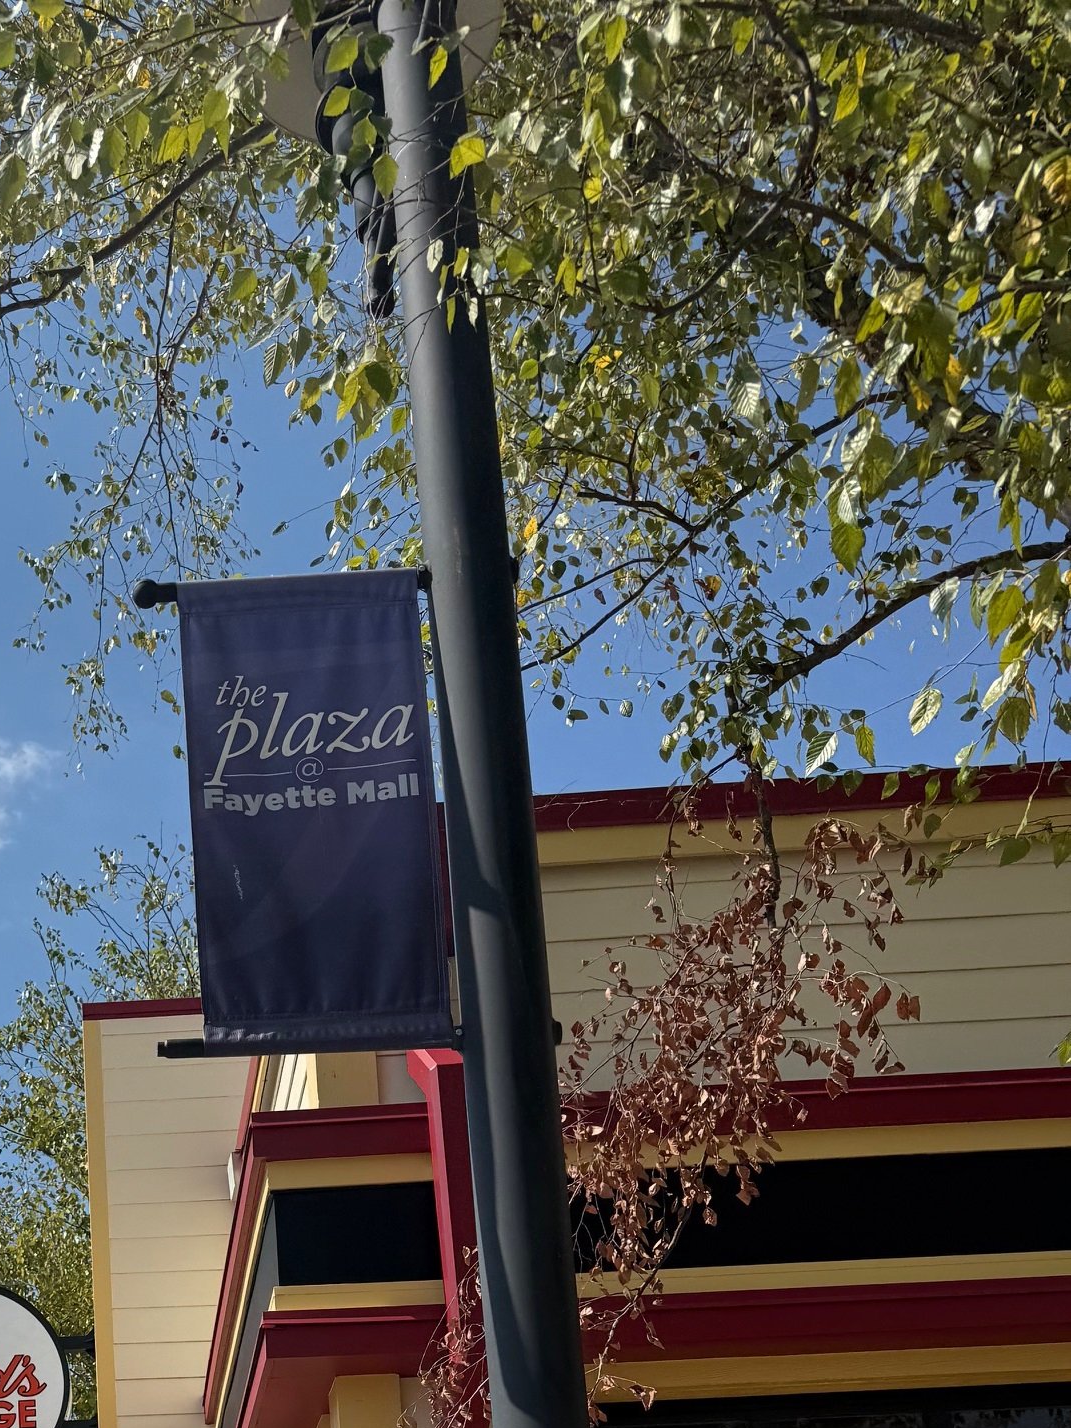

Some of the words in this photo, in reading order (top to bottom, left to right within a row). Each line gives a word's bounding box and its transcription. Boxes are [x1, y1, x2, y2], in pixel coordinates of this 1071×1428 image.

[215, 675, 267, 708] the
[203, 692, 415, 787] plaza
[295, 756, 324, 784] @
[203, 784, 337, 817] Fayette
[346, 772, 420, 805] Mall
